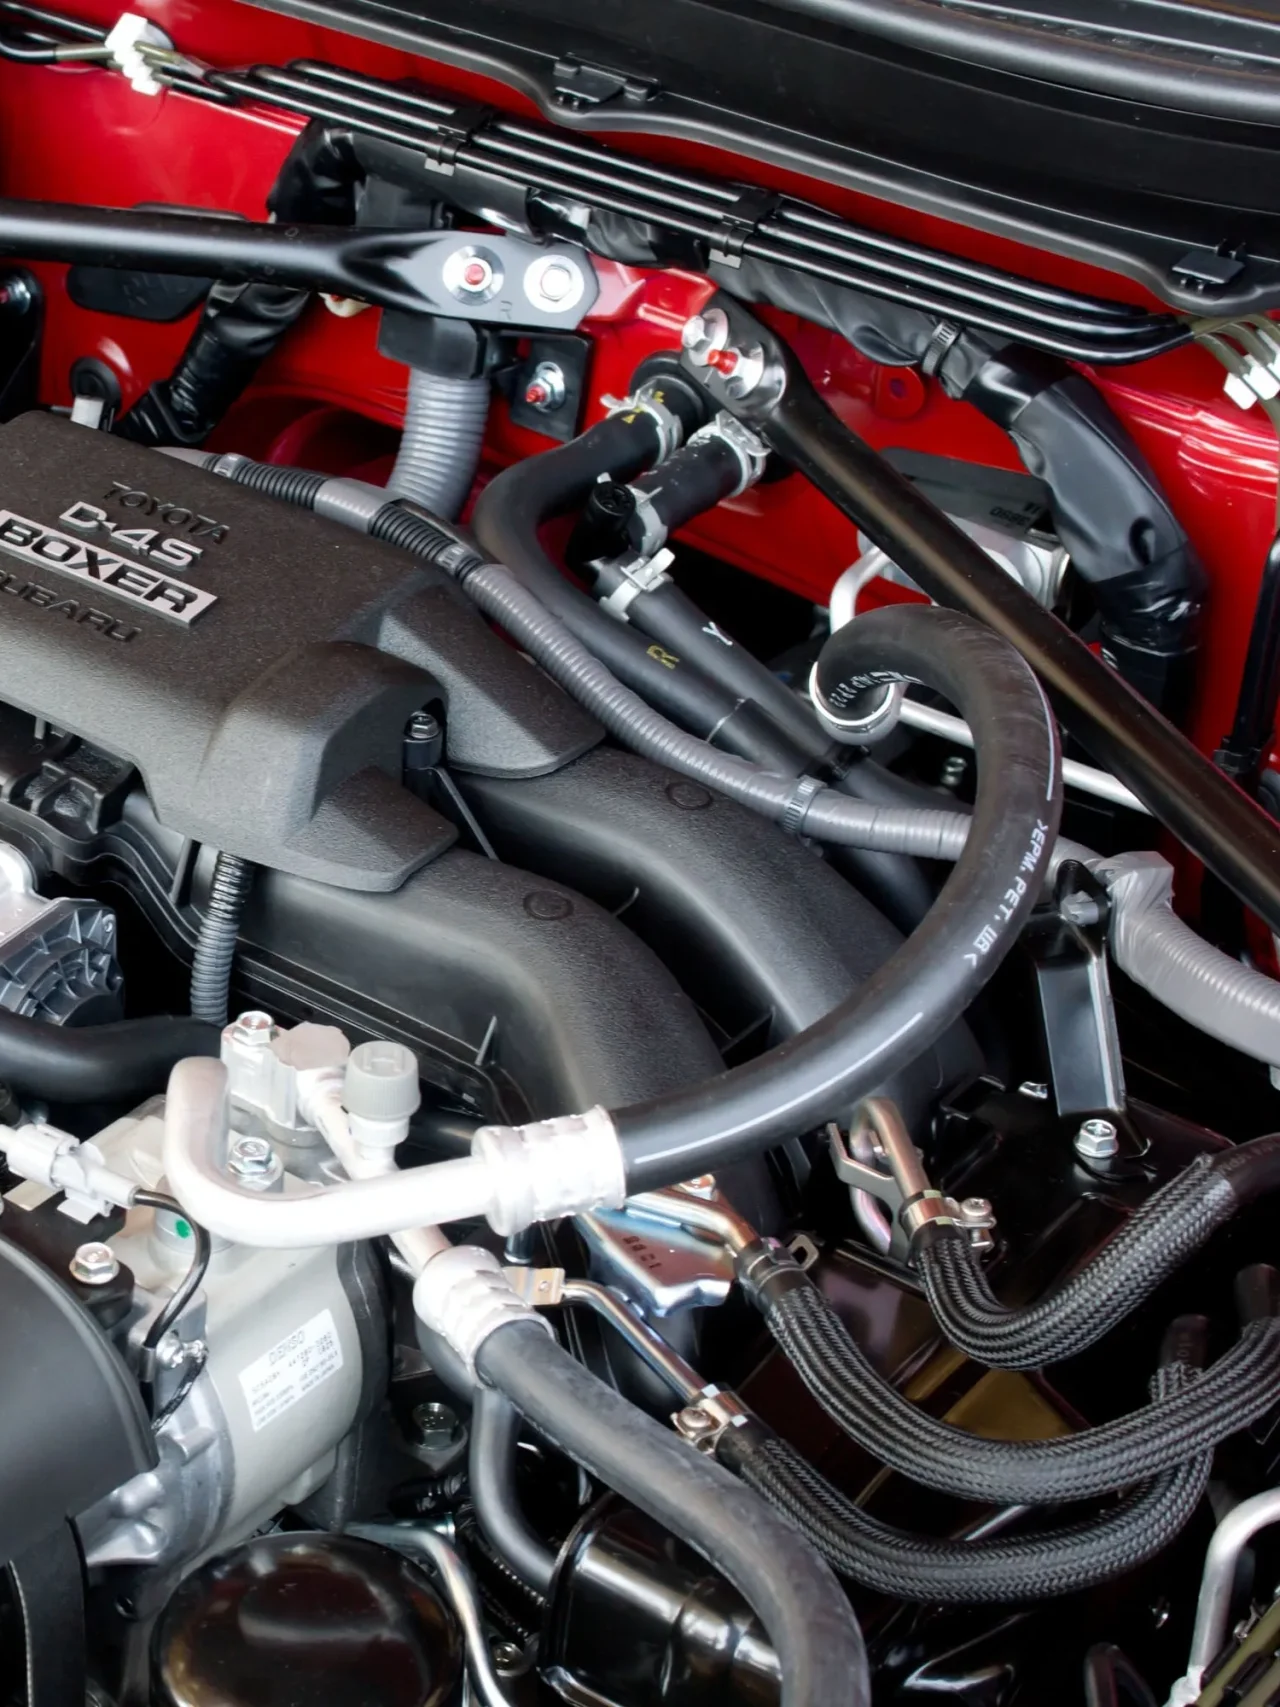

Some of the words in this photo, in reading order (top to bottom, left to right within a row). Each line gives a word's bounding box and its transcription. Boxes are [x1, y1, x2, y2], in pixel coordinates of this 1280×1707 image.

[59, 501, 203, 572] D-4S
[103, 481, 230, 544] TOYOTA
[702, 621, 733, 646] Y
